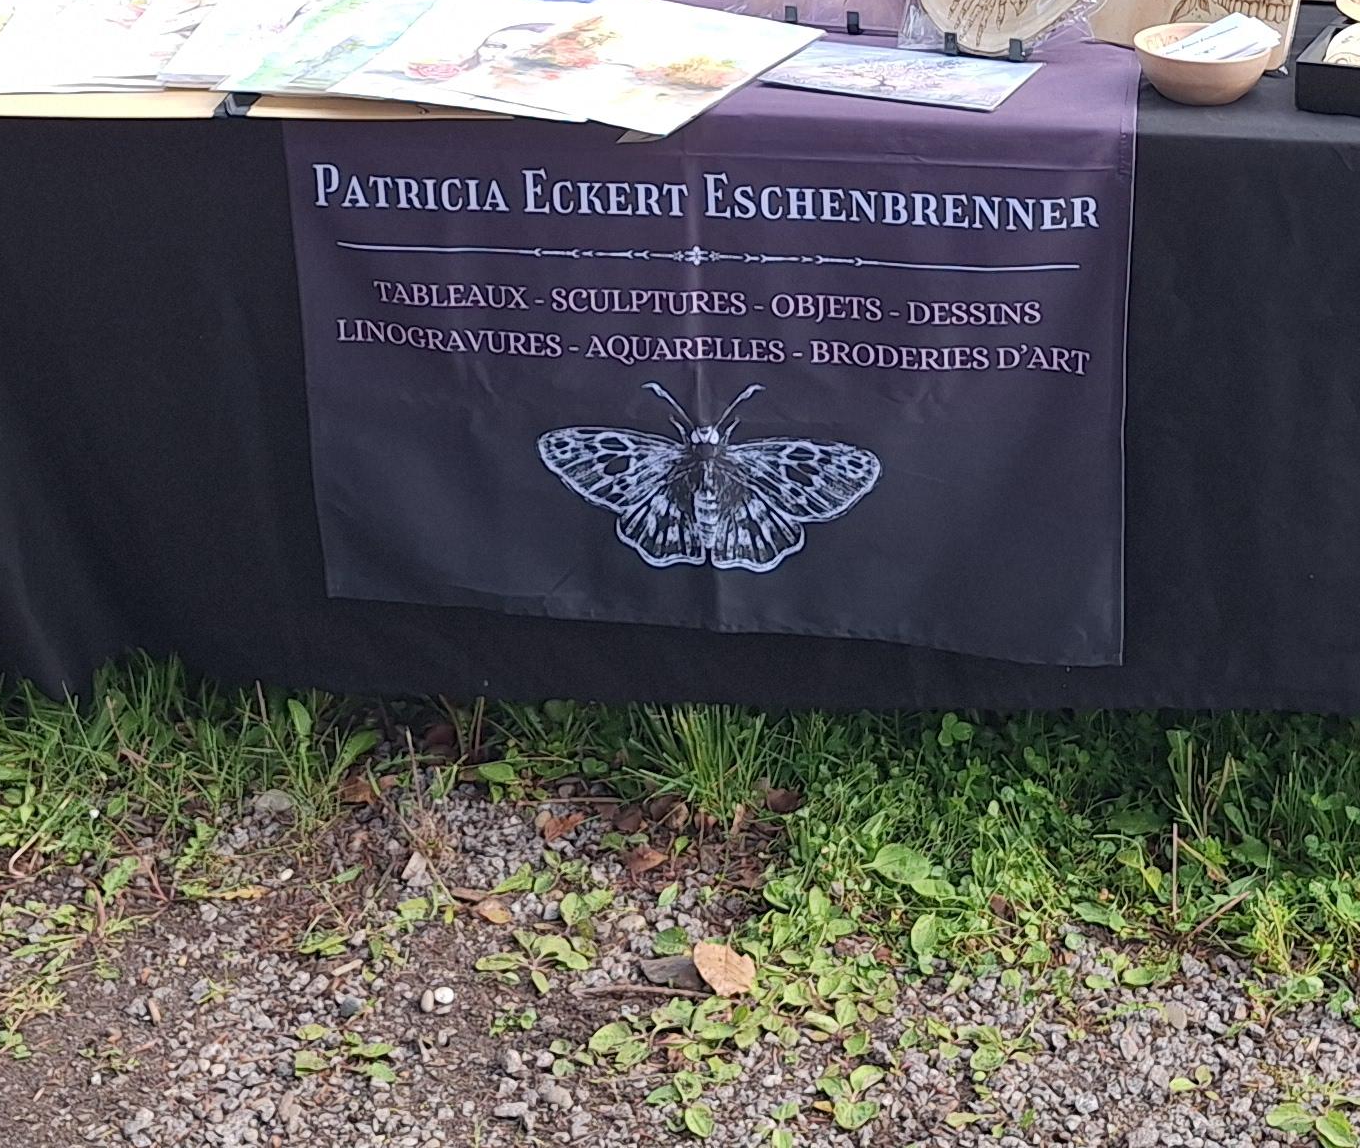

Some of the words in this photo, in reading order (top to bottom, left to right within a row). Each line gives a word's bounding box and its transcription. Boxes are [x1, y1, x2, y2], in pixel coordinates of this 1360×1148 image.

[312, 163, 510, 212] PATRICIA
[521, 167, 689, 218] ECKERT
[703, 171, 1100, 231] ESCHENBRENNER
[373, 280, 530, 311] TABLEAUX
[551, 287, 747, 316] SCULPTURES
[771, 293, 883, 323] OBJETS
[907, 301, 1041, 326] DESSINS
[337, 318, 563, 358] LINOGRAVURES
[585, 334, 786, 366] AQUARELLES
[810, 339, 990, 371] BRODERIES
